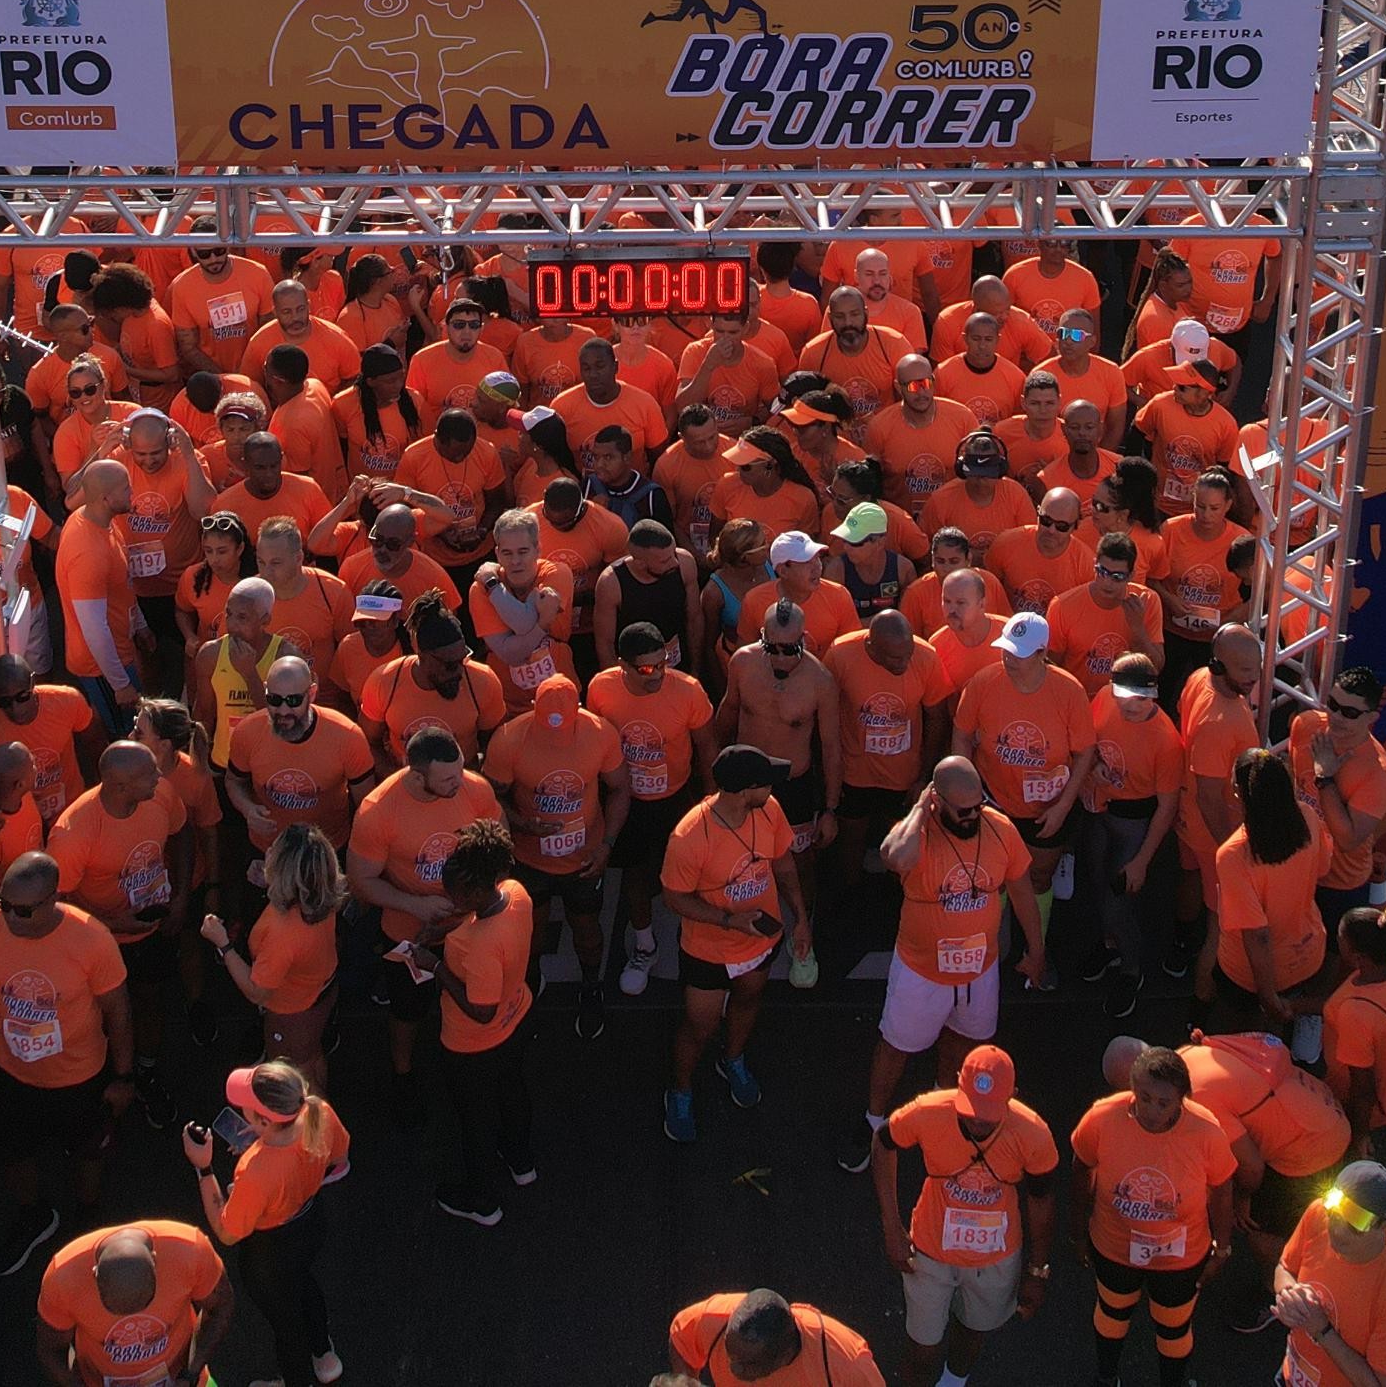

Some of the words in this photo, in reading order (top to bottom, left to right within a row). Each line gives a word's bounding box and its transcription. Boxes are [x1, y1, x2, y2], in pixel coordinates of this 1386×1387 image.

[905, 3, 1020, 53] 50
[1155, 29, 1264, 40] PREFEITURA
[0, 50, 113, 96] RIO
[668, 35, 892, 95] BORA
[897, 61, 1015, 79] COMLURB
[1152, 43, 1263, 90] RIO
[19, 110, 103, 126] Comlurb
[229, 102, 610, 151] CHEGADA
[711, 87, 1033, 148] CORRER
[1175, 112, 1233, 124] Esportes
[536, 261, 743, 311] 00:00:00
[213, 303, 244, 321] 1911
[132, 522, 170, 534] CORRER
[517, 658, 553, 683] 1513
[995, 744, 1027, 758] BORA
[1001, 754, 1046, 769] CORRER
[1026, 776, 1064, 795] 1534
[539, 800, 582, 814] CORRER
[544, 831, 584, 851] 1066
[940, 946, 983, 966] 1658
[9, 1003, 58, 1022] CORRER
[10, 1033, 56, 1054] 1854
[951, 1226, 1000, 1246] 1831
